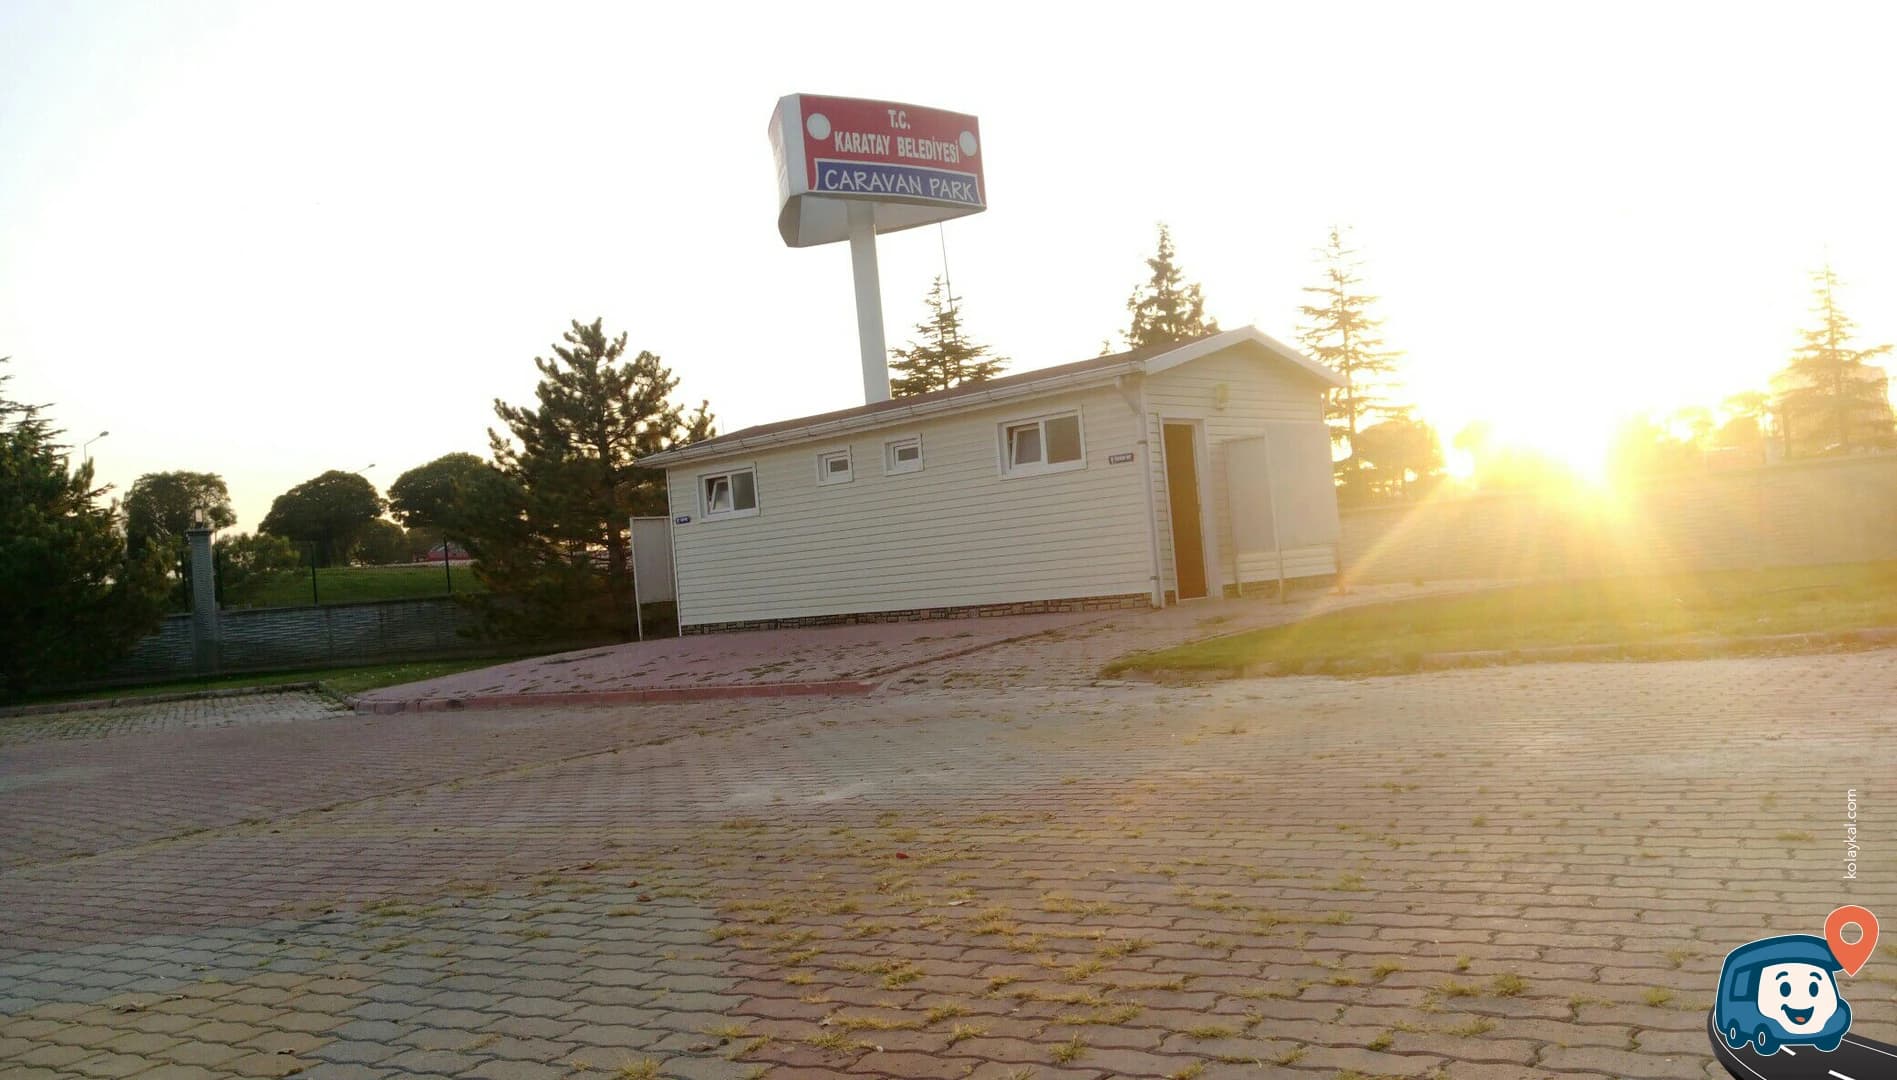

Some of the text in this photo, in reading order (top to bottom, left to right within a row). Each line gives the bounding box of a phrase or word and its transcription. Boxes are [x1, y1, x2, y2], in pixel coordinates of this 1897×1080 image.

[888, 109, 911, 129] T.C.
[834, 130, 960, 164] KARATAY BELEDİYESİ
[825, 169, 974, 201] CARAVAN PARK
